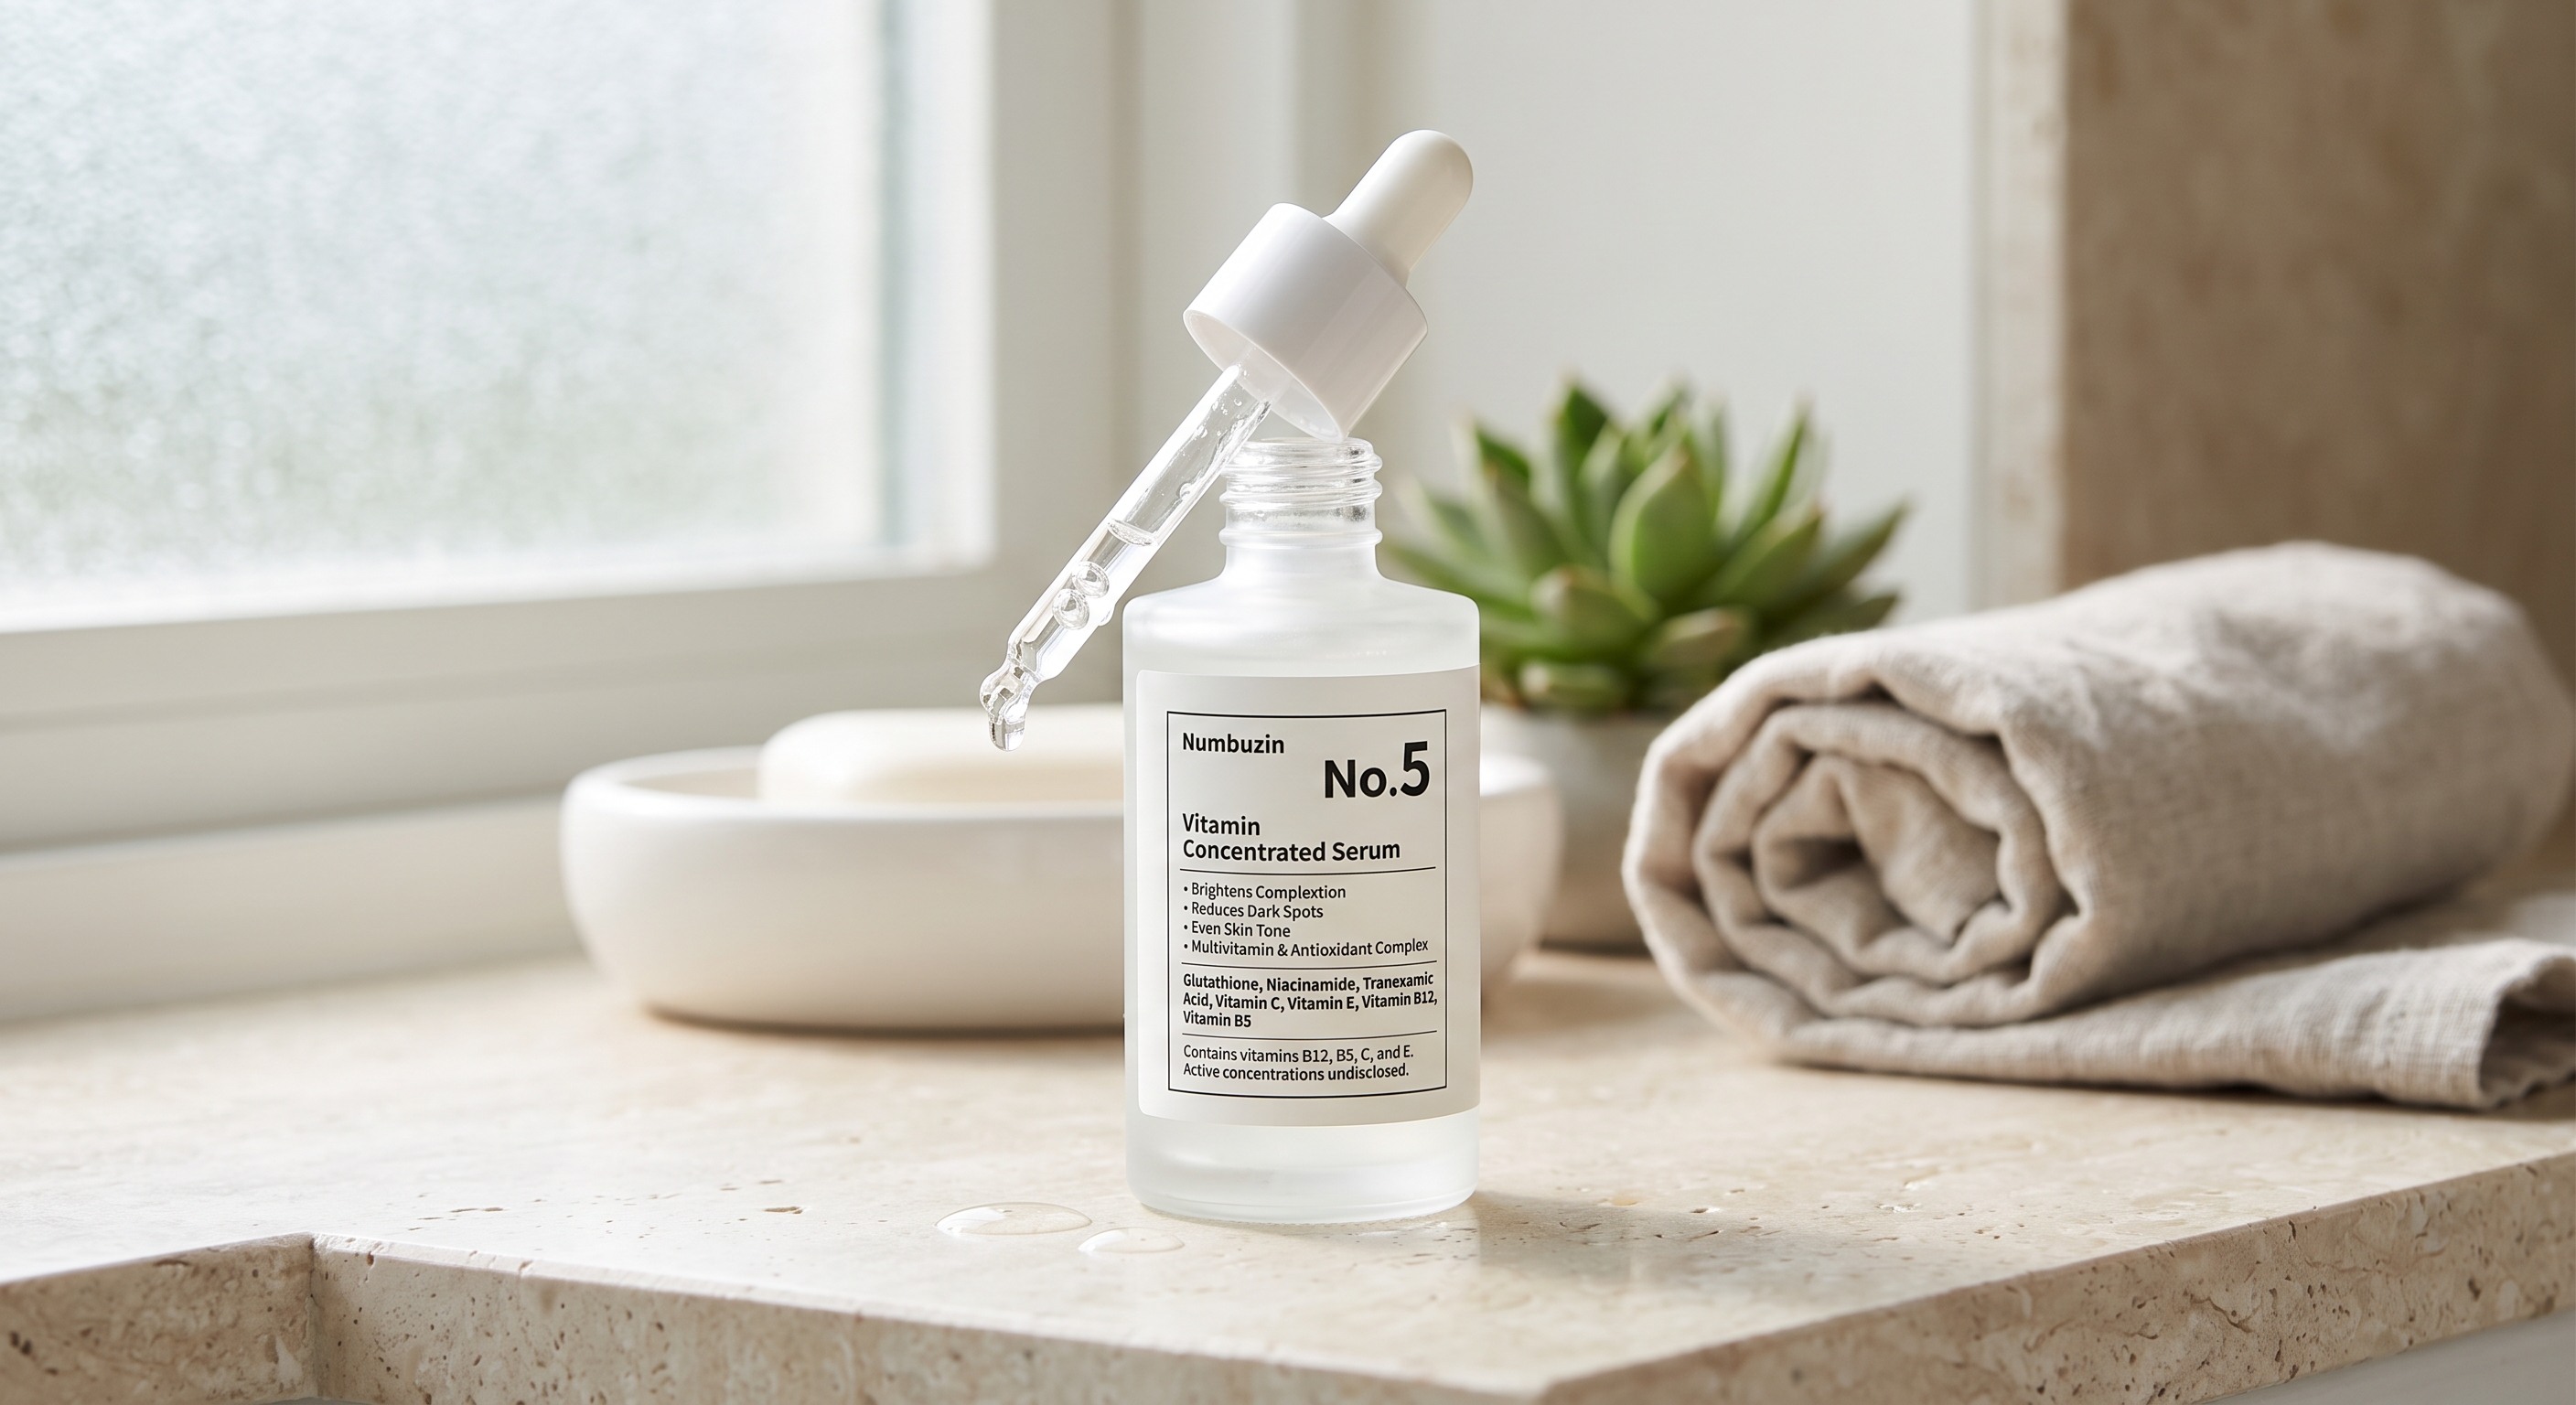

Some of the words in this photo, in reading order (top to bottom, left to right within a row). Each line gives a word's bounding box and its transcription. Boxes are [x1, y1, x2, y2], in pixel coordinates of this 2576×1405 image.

[1184, 733, 1284, 754] Numbuzin
[1325, 741, 1430, 799] No.5
[1183, 813, 1260, 835] Vitamin
[1184, 840, 1326, 862] Concentrated
[1332, 842, 1400, 861] Serum
[1192, 883, 1252, 900] Brightens
[1256, 885, 1346, 902] Complextion
[1192, 902, 1244, 917] Reduces
[1248, 905, 1280, 917] Dark
[1283, 905, 1324, 921] Spots
[1192, 921, 1220, 935] Even
[1224, 922, 1252, 936] Skin
[1256, 924, 1291, 938] Tone
[1192, 939, 1273, 956] Multivitamin
[1277, 944, 1288, 956] &
[1291, 941, 1372, 957] Antioxidant
[1375, 938, 1428, 956] Complex
[1184, 973, 1262, 993] Glutathione,
[1267, 977, 1359, 993] Niacinamide,
[1363, 971, 1433, 990] Tranexamic
[1184, 992, 1213, 1010] Acid,
[1216, 994, 1267, 1009] Vitamin
[1271, 997, 1284, 1013] C,
[1287, 996, 1343, 1010] Vitamin
[1347, 996, 1359, 1012] E,
[1361, 992, 1411, 1008] Vitamin
[1414, 991, 1437, 1005] B12,
[1184, 1010, 1230, 1026] Vitamin
[1235, 1014, 1251, 1027] B5
[1184, 1045, 1237, 1060] Contains
[1240, 1048, 1299, 1062] vitamins
[1303, 1050, 1333, 1065] B12,
[1336, 1049, 1358, 1064] B5,
[1361, 1048, 1373, 1063] C,
[1377, 1045, 1400, 1060] and
[1403, 1045, 1413, 1057] E.
[1184, 1063, 1219, 1078] Active
[1223, 1067, 1325, 1081] concentrations
[1328, 1063, 1409, 1080] undisclosed.
